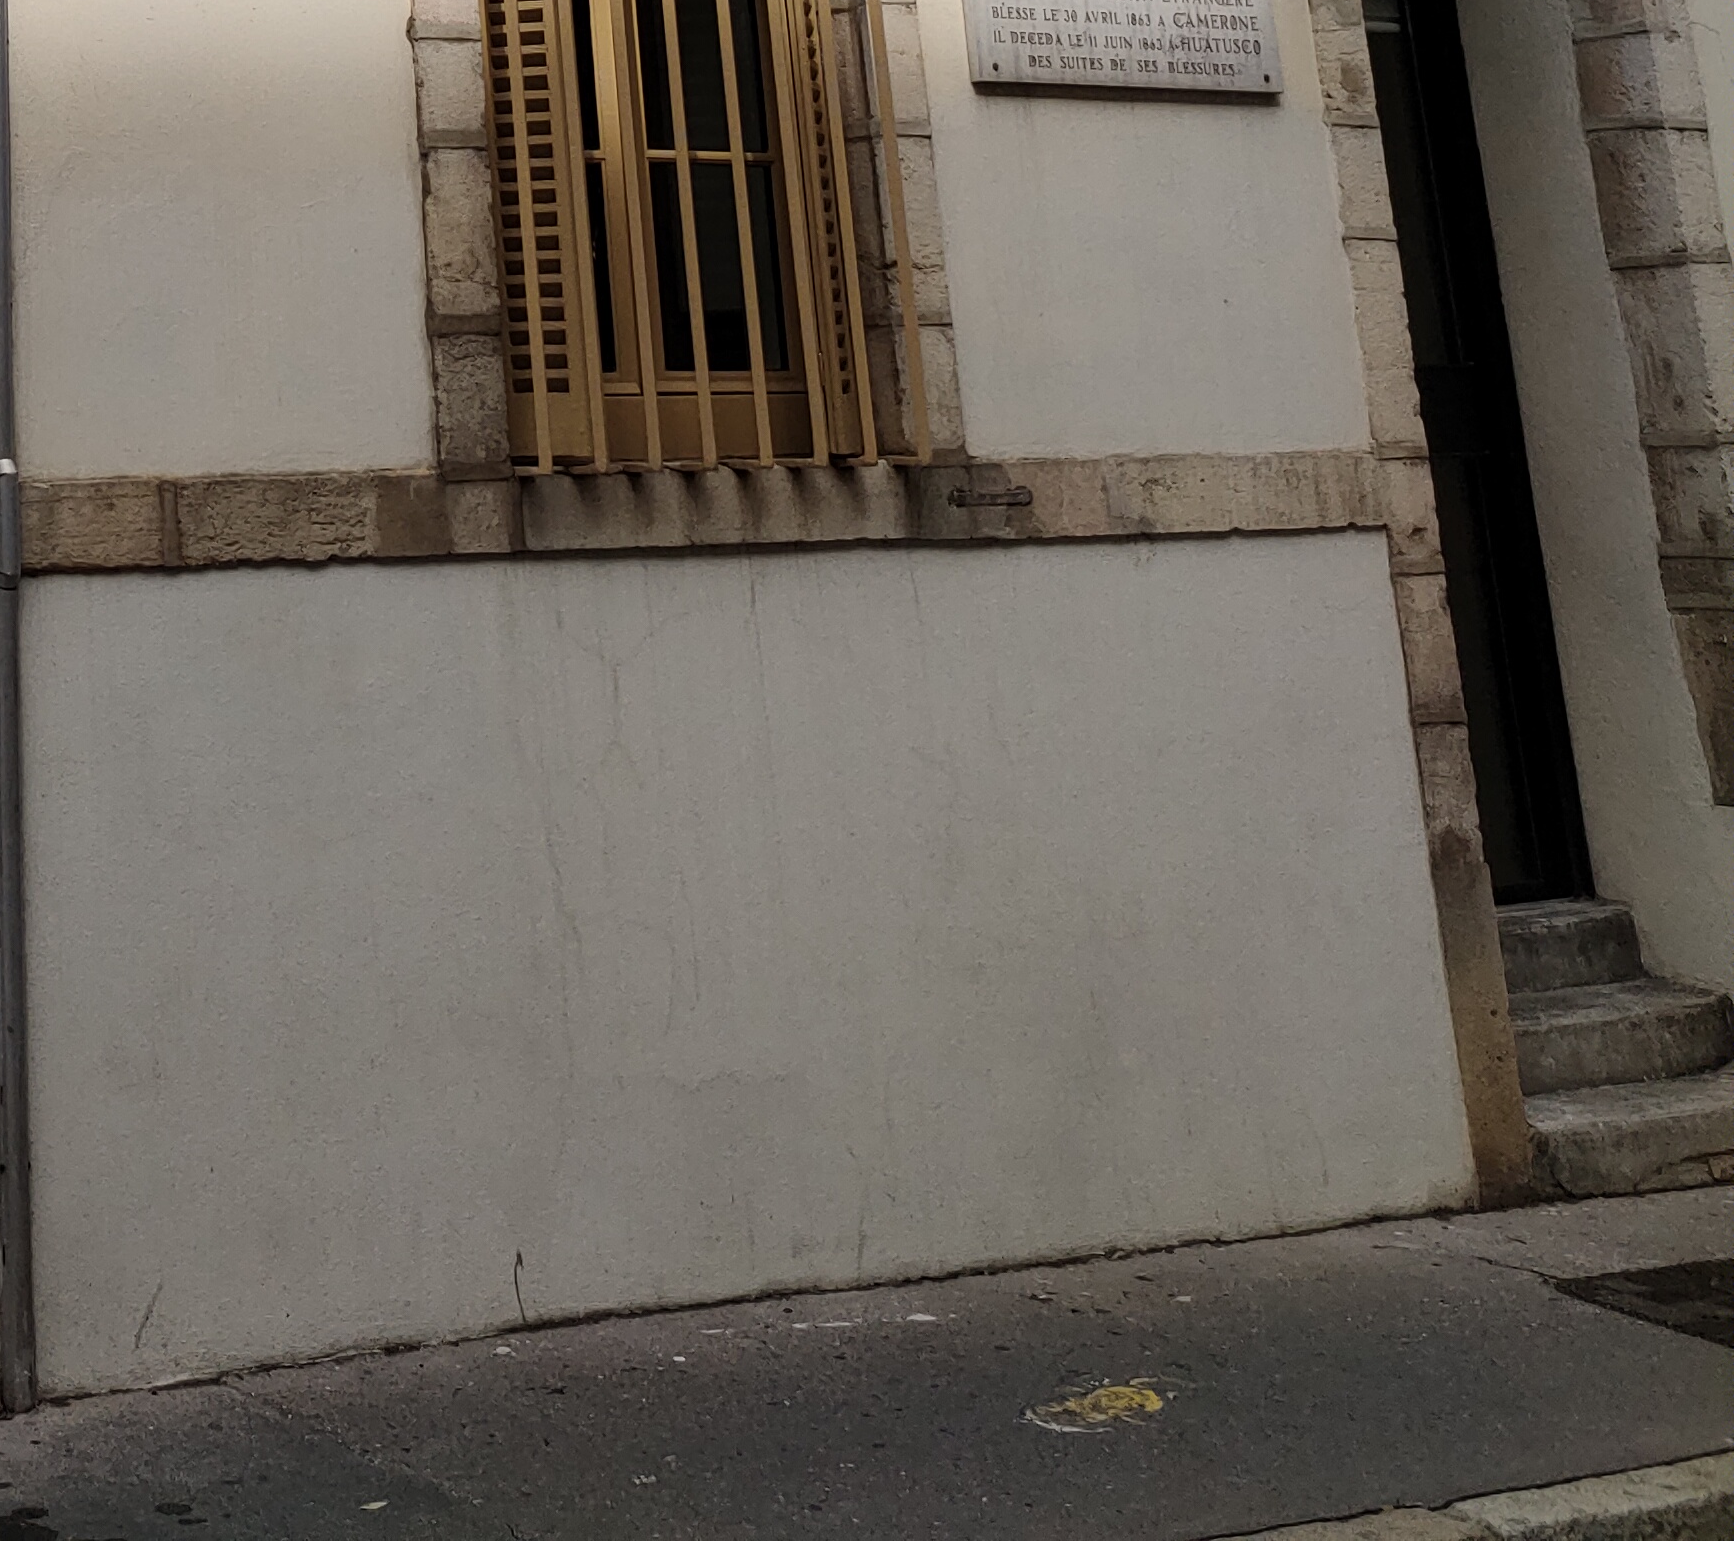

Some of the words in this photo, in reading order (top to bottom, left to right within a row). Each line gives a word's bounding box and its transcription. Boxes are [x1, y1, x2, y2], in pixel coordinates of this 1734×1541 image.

[1042, 8, 1060, 22] LE
[1063, 9, 1078, 23] 30
[1084, 10, 1121, 26] AVRIL
[1172, 11, 1260, 32] CAMERONE
[993, 29, 1006, 44] IL
[1067, 33, 1084, 47] LE
[1103, 35, 1133, 50] JUIN
[1180, 36, 1262, 55] HUATUSCO
[1027, 54, 1053, 69] DES
[1059, 55, 1104, 71] SUITES
[1110, 57, 1127, 72] DE
[1137, 59, 1158, 73] SES
